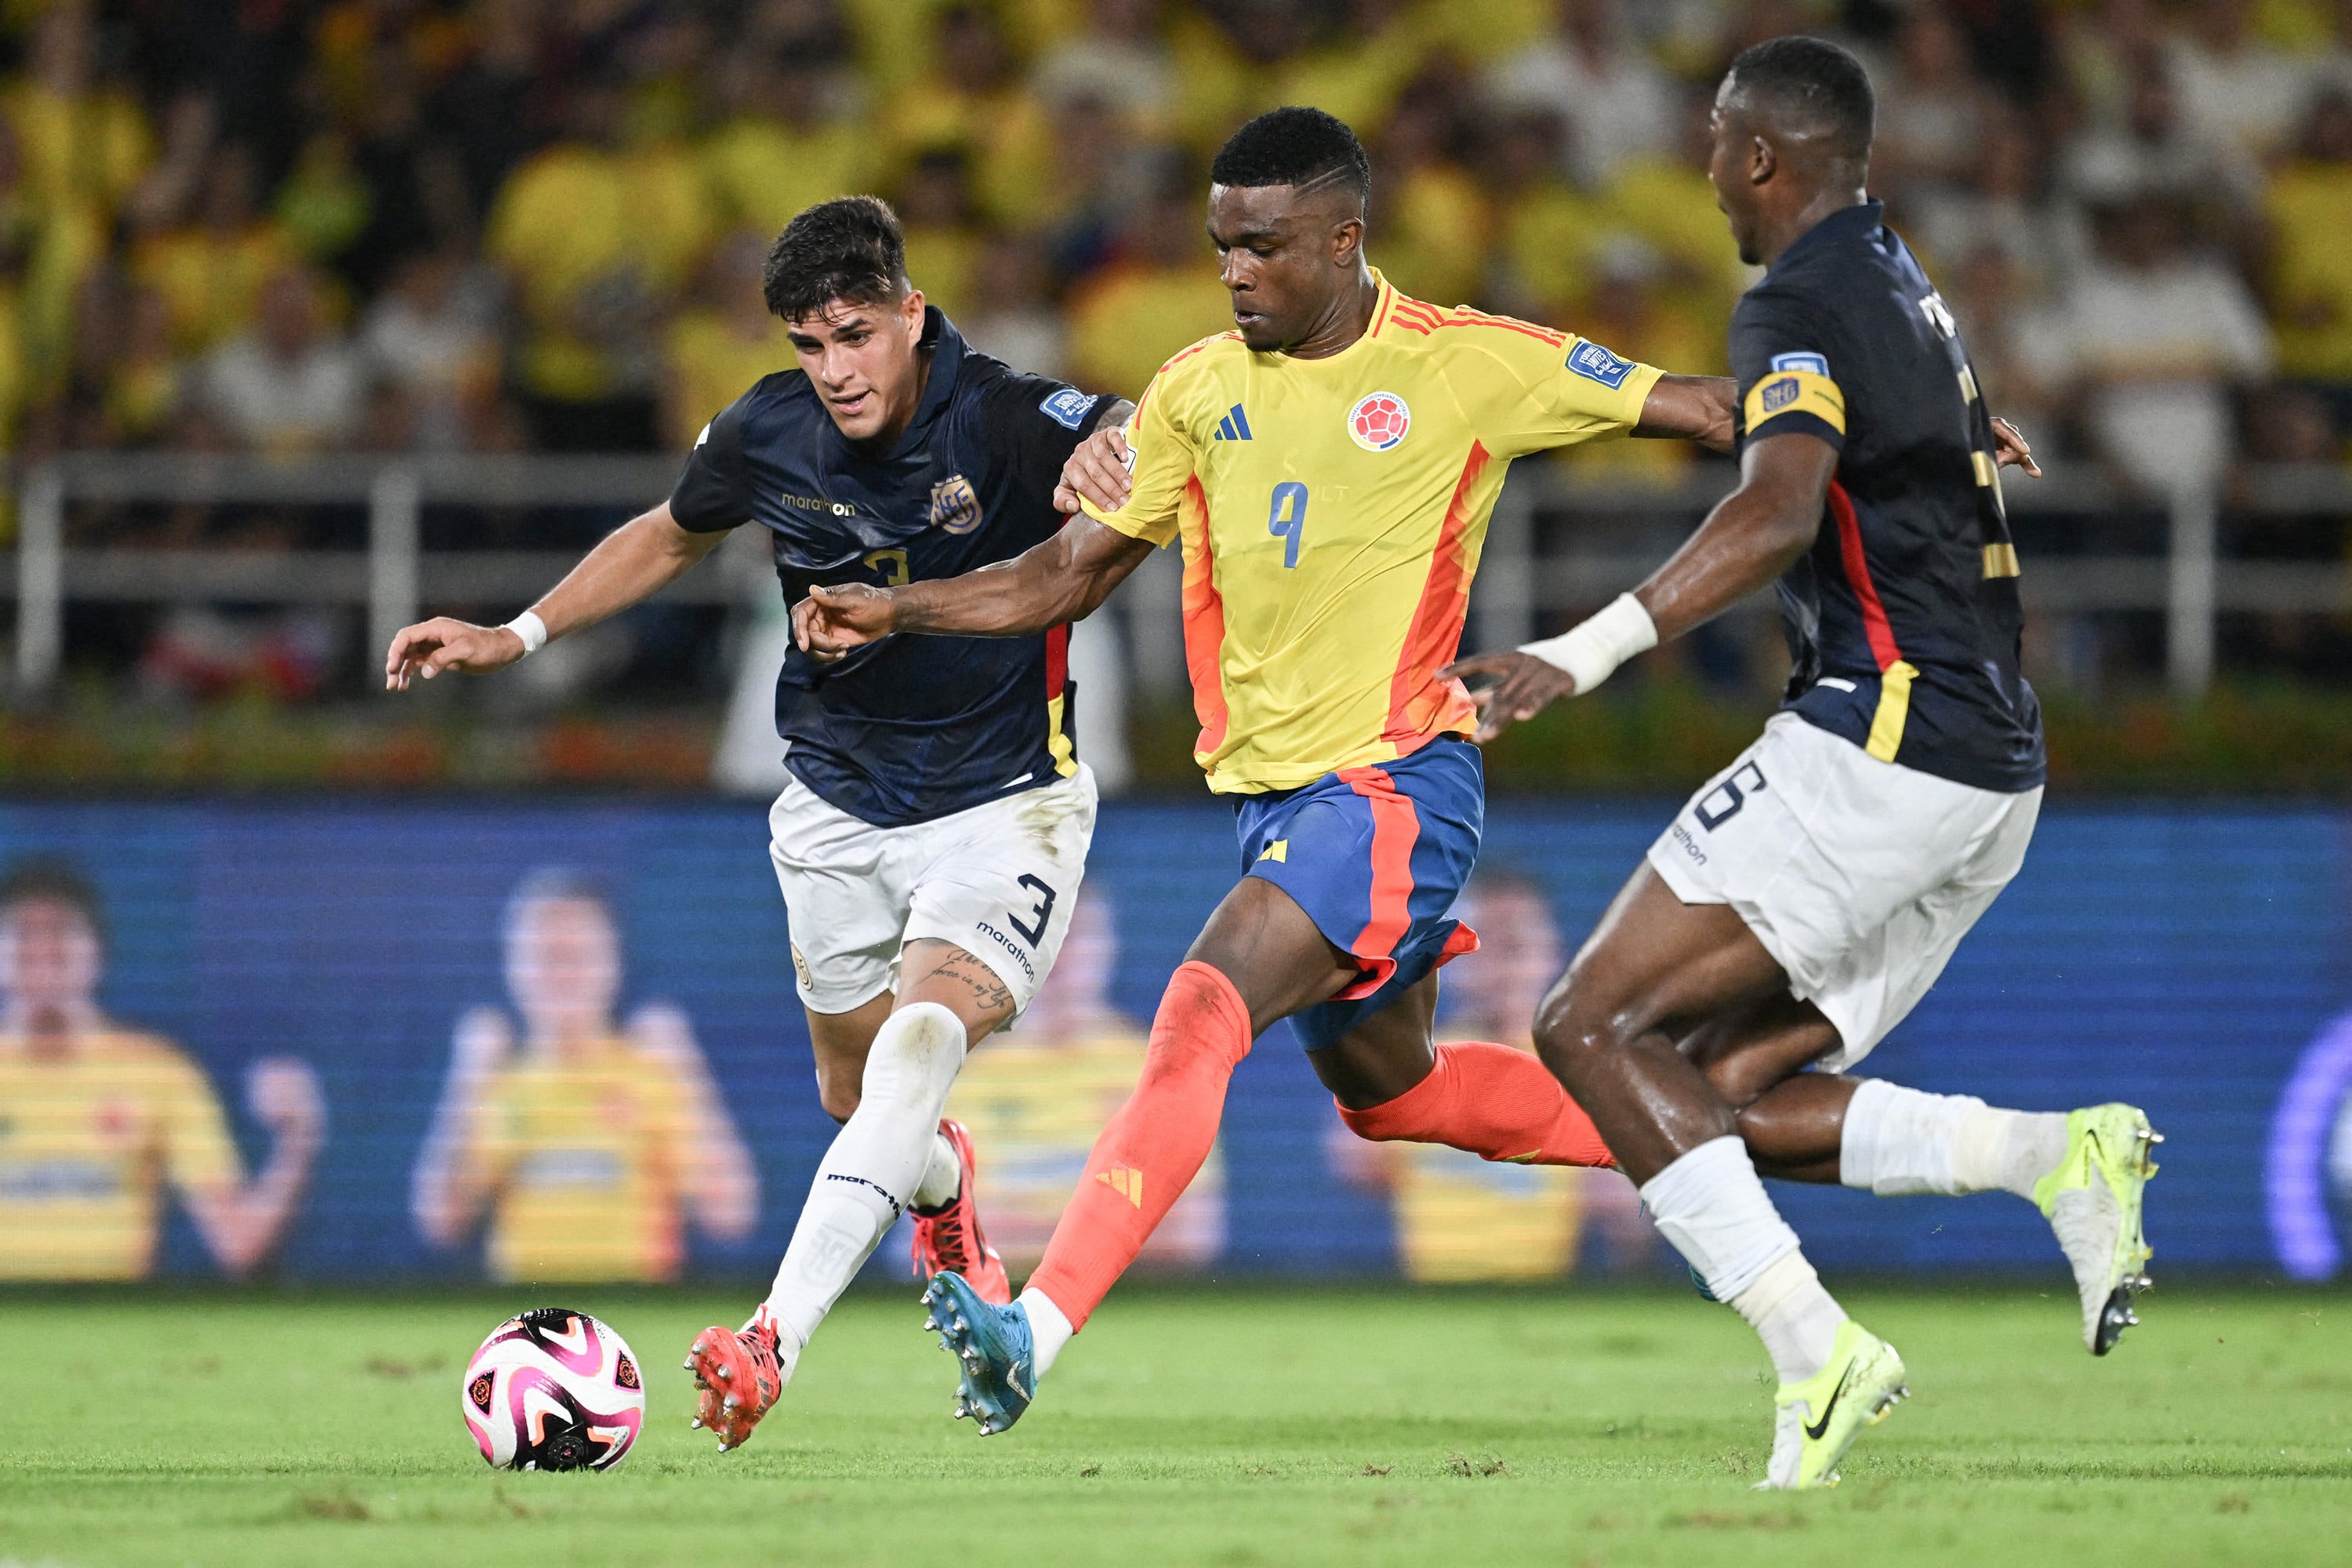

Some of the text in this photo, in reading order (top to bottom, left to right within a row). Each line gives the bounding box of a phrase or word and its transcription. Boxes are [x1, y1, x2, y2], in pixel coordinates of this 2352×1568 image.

[782, 493, 856, 517] marathon
[1269, 481, 1308, 568] 9
[1694, 760, 1768, 833] 6
[1007, 873, 1057, 949] 3
[977, 921, 1035, 984] marathon
